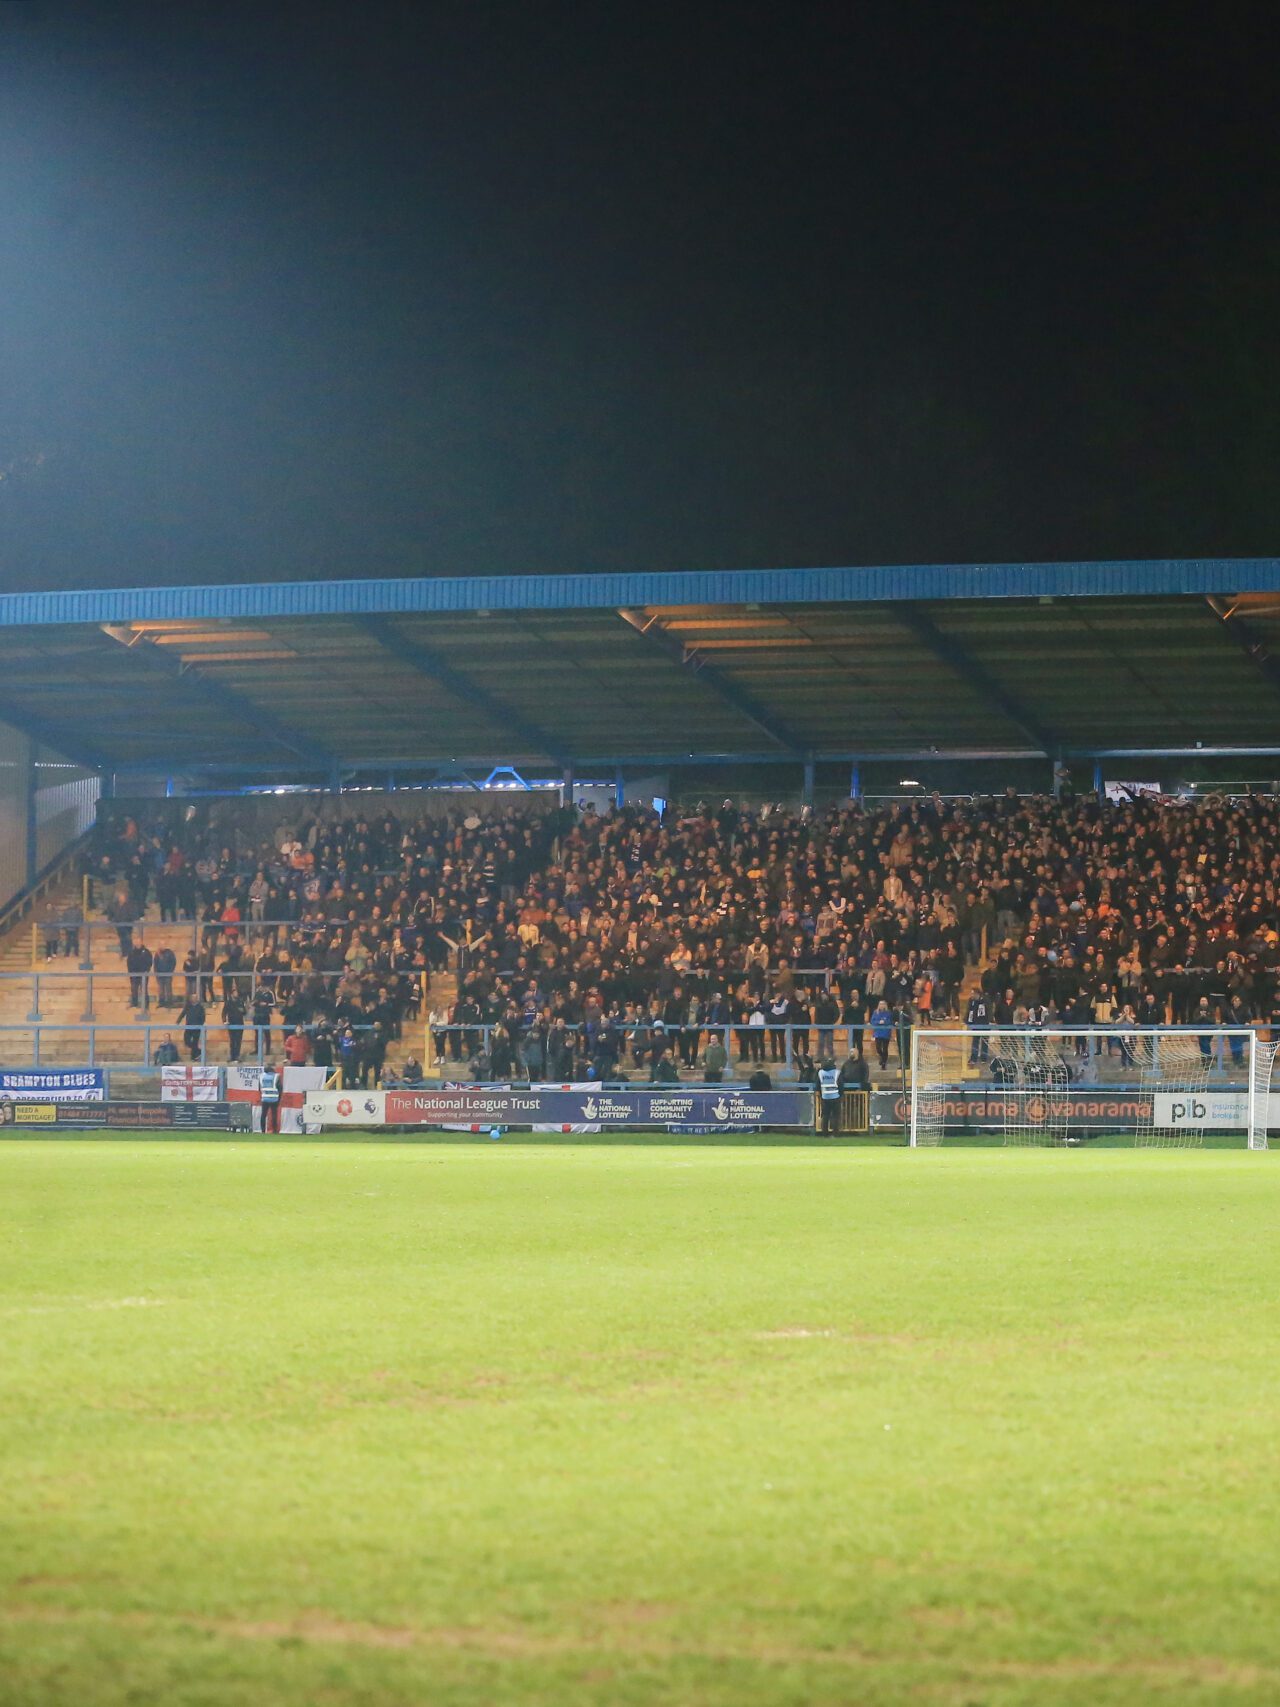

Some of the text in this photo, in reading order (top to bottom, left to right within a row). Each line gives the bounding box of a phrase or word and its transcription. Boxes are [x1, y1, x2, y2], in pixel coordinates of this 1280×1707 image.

[3, 1073, 96, 1087] BRAMPTON BLUES
[391, 1097, 541, 1112] The National League Trust
[1050, 1102, 1150, 1118] vanarama
[1171, 1099, 1206, 1122] pib
